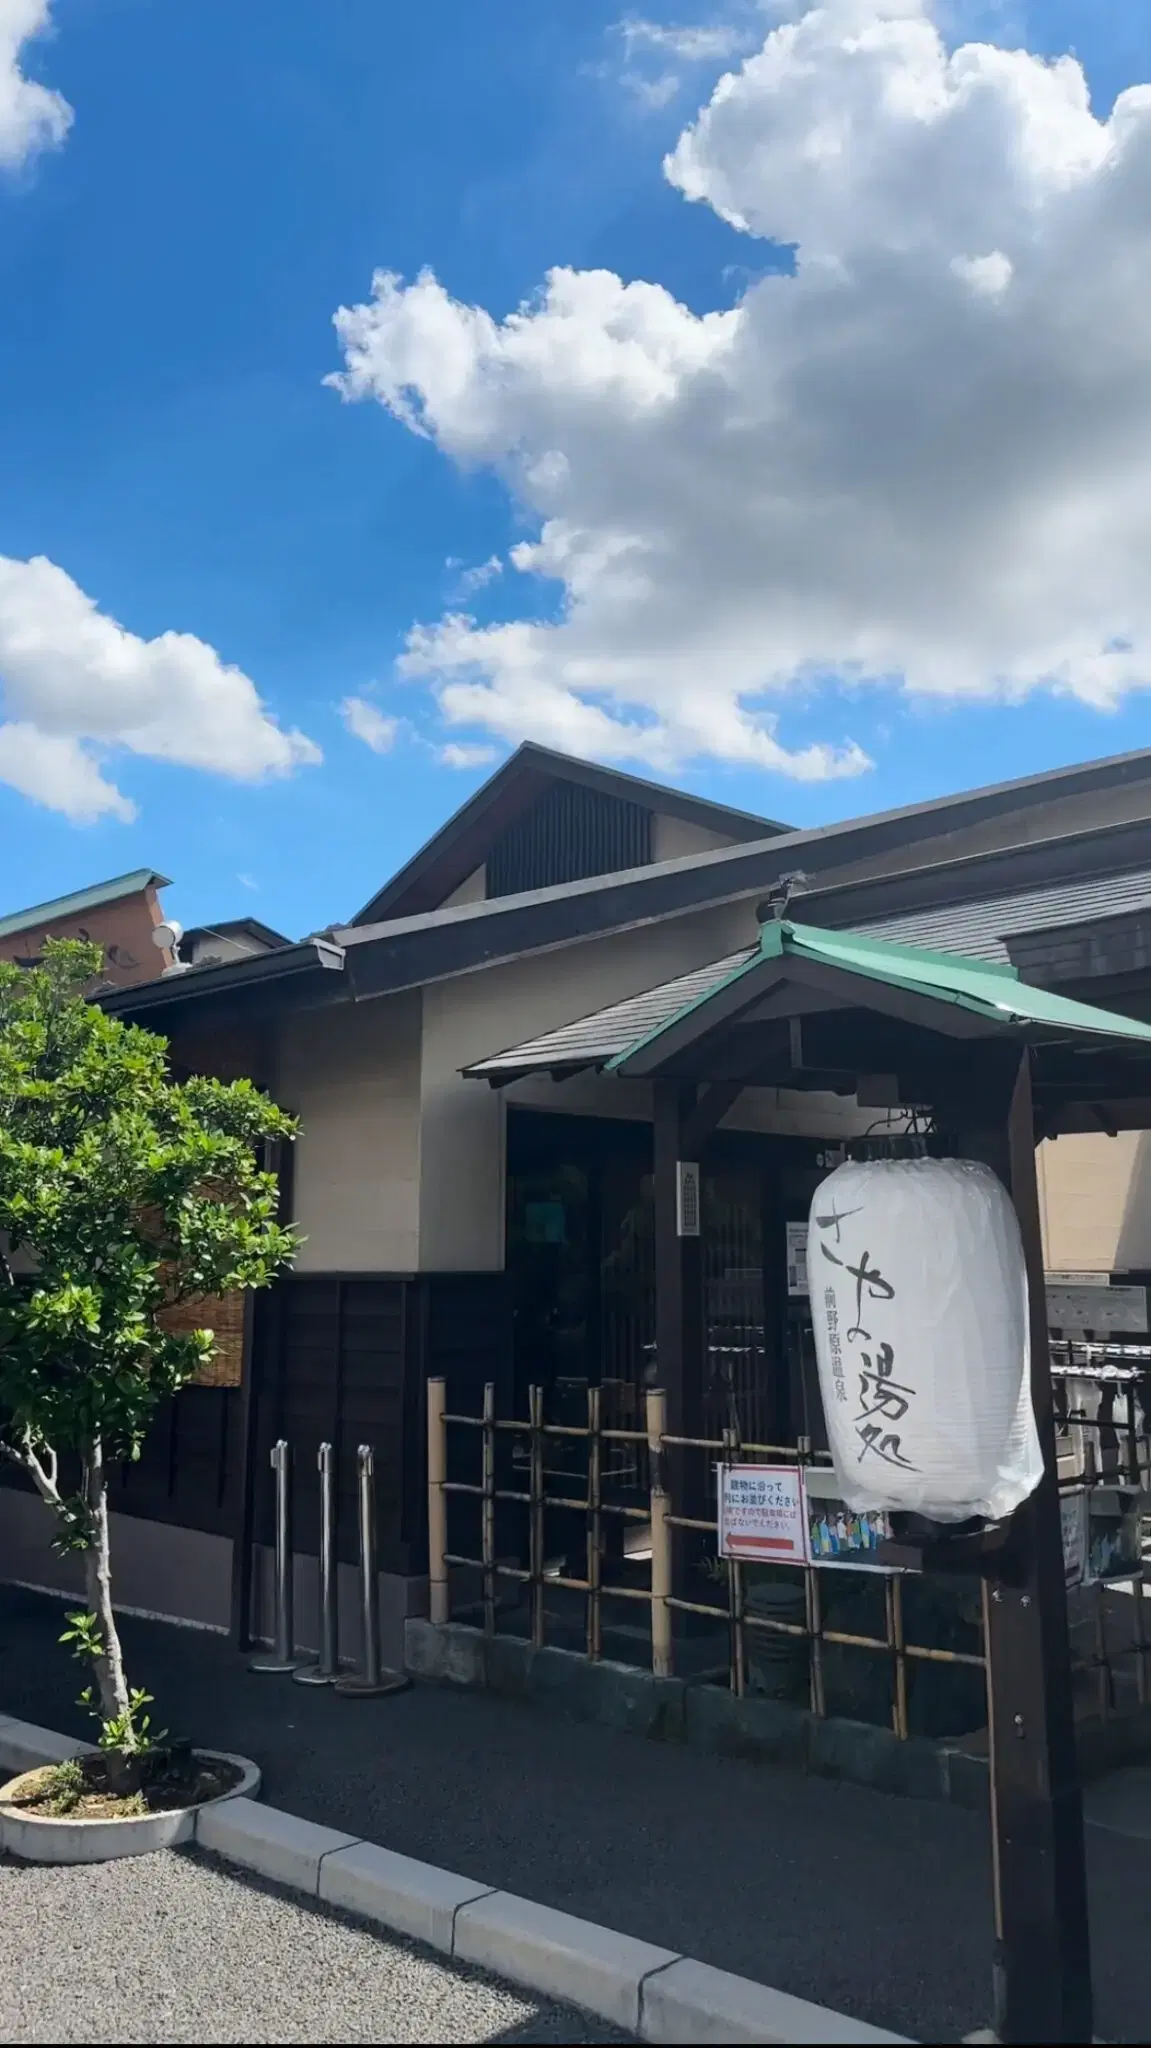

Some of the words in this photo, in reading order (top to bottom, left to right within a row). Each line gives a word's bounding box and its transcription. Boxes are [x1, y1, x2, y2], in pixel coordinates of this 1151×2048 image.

[816, 1196, 923, 1472] さやの湯処
[824, 1286, 847, 1402] 前野原温泉
[730, 1479, 783, 1492] 建物に沿って
